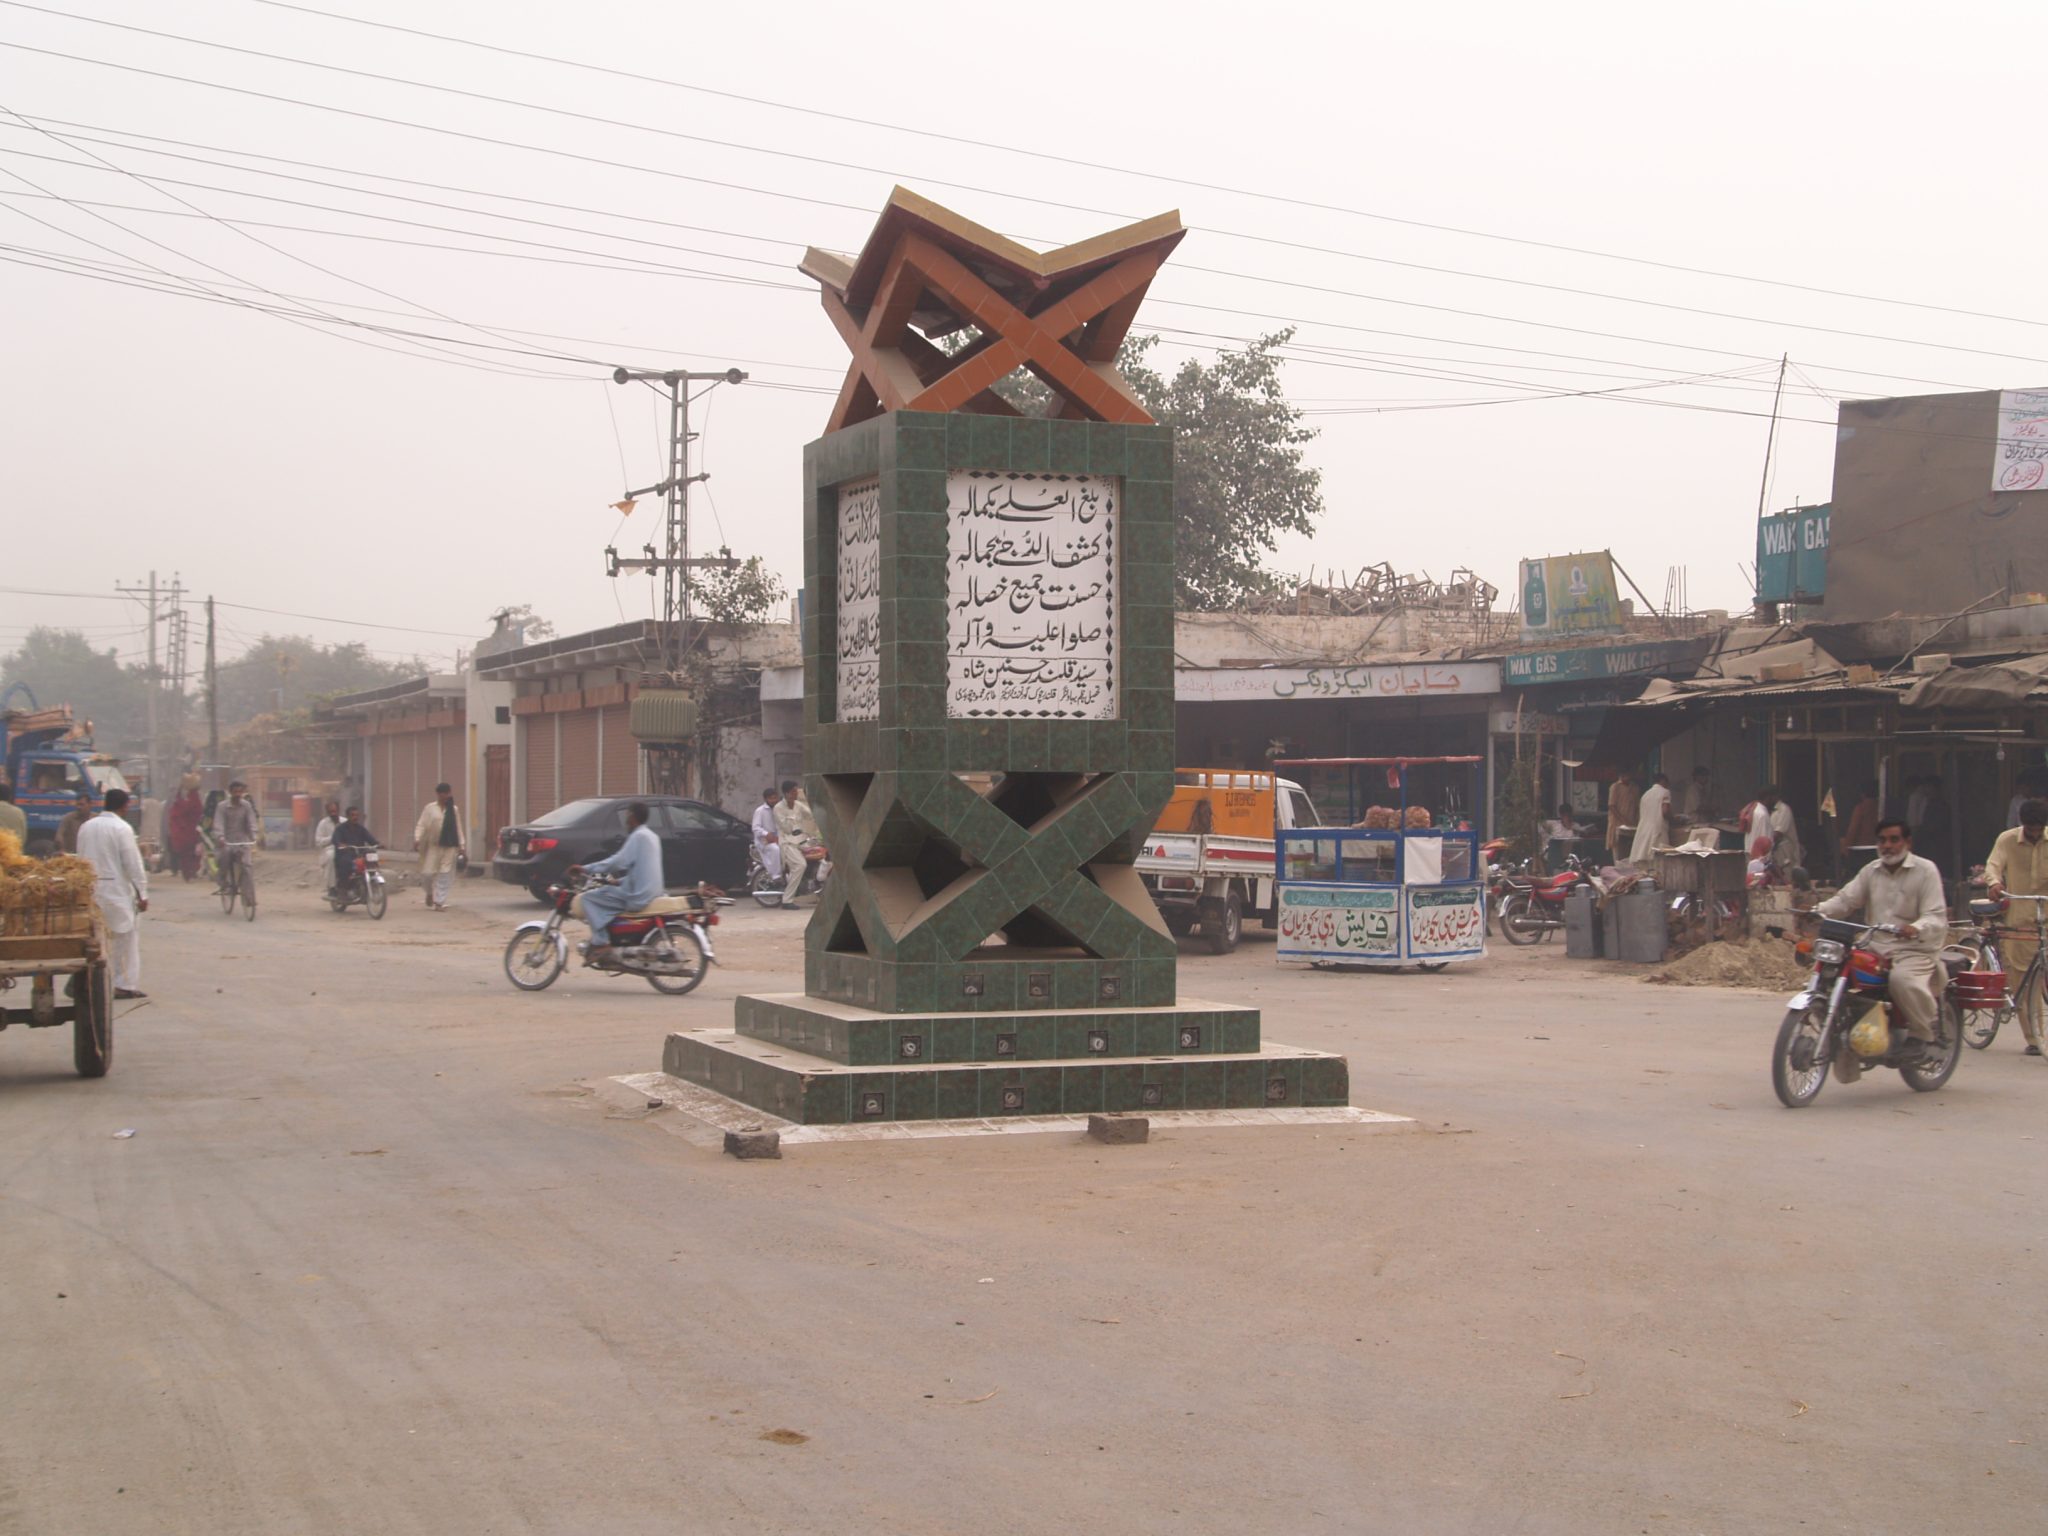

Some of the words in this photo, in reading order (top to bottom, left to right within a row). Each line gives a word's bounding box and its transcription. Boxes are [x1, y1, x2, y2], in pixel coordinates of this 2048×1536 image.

[1078, 487, 1100, 524] بلغ
[1051, 533, 1102, 569] کشف
[1763, 522, 1797, 556] WAK
[1009, 573, 1046, 614] جمیع
[1039, 582, 1102, 611] حسنت
[1061, 620, 1101, 652] صلوا
[964, 659, 985, 680] شاہ
[983, 658, 1049, 689] حسنین
[1020, 660, 1078, 685] قلندر
[1510, 659, 1532, 676] WAK
[1536, 654, 1557, 673] GAS
[1605, 652, 1636, 674] WAK
[1379, 667, 1461, 694] جاپان
[1336, 909, 1388, 948] فریش
[1449, 907, 1480, 941] فریش
